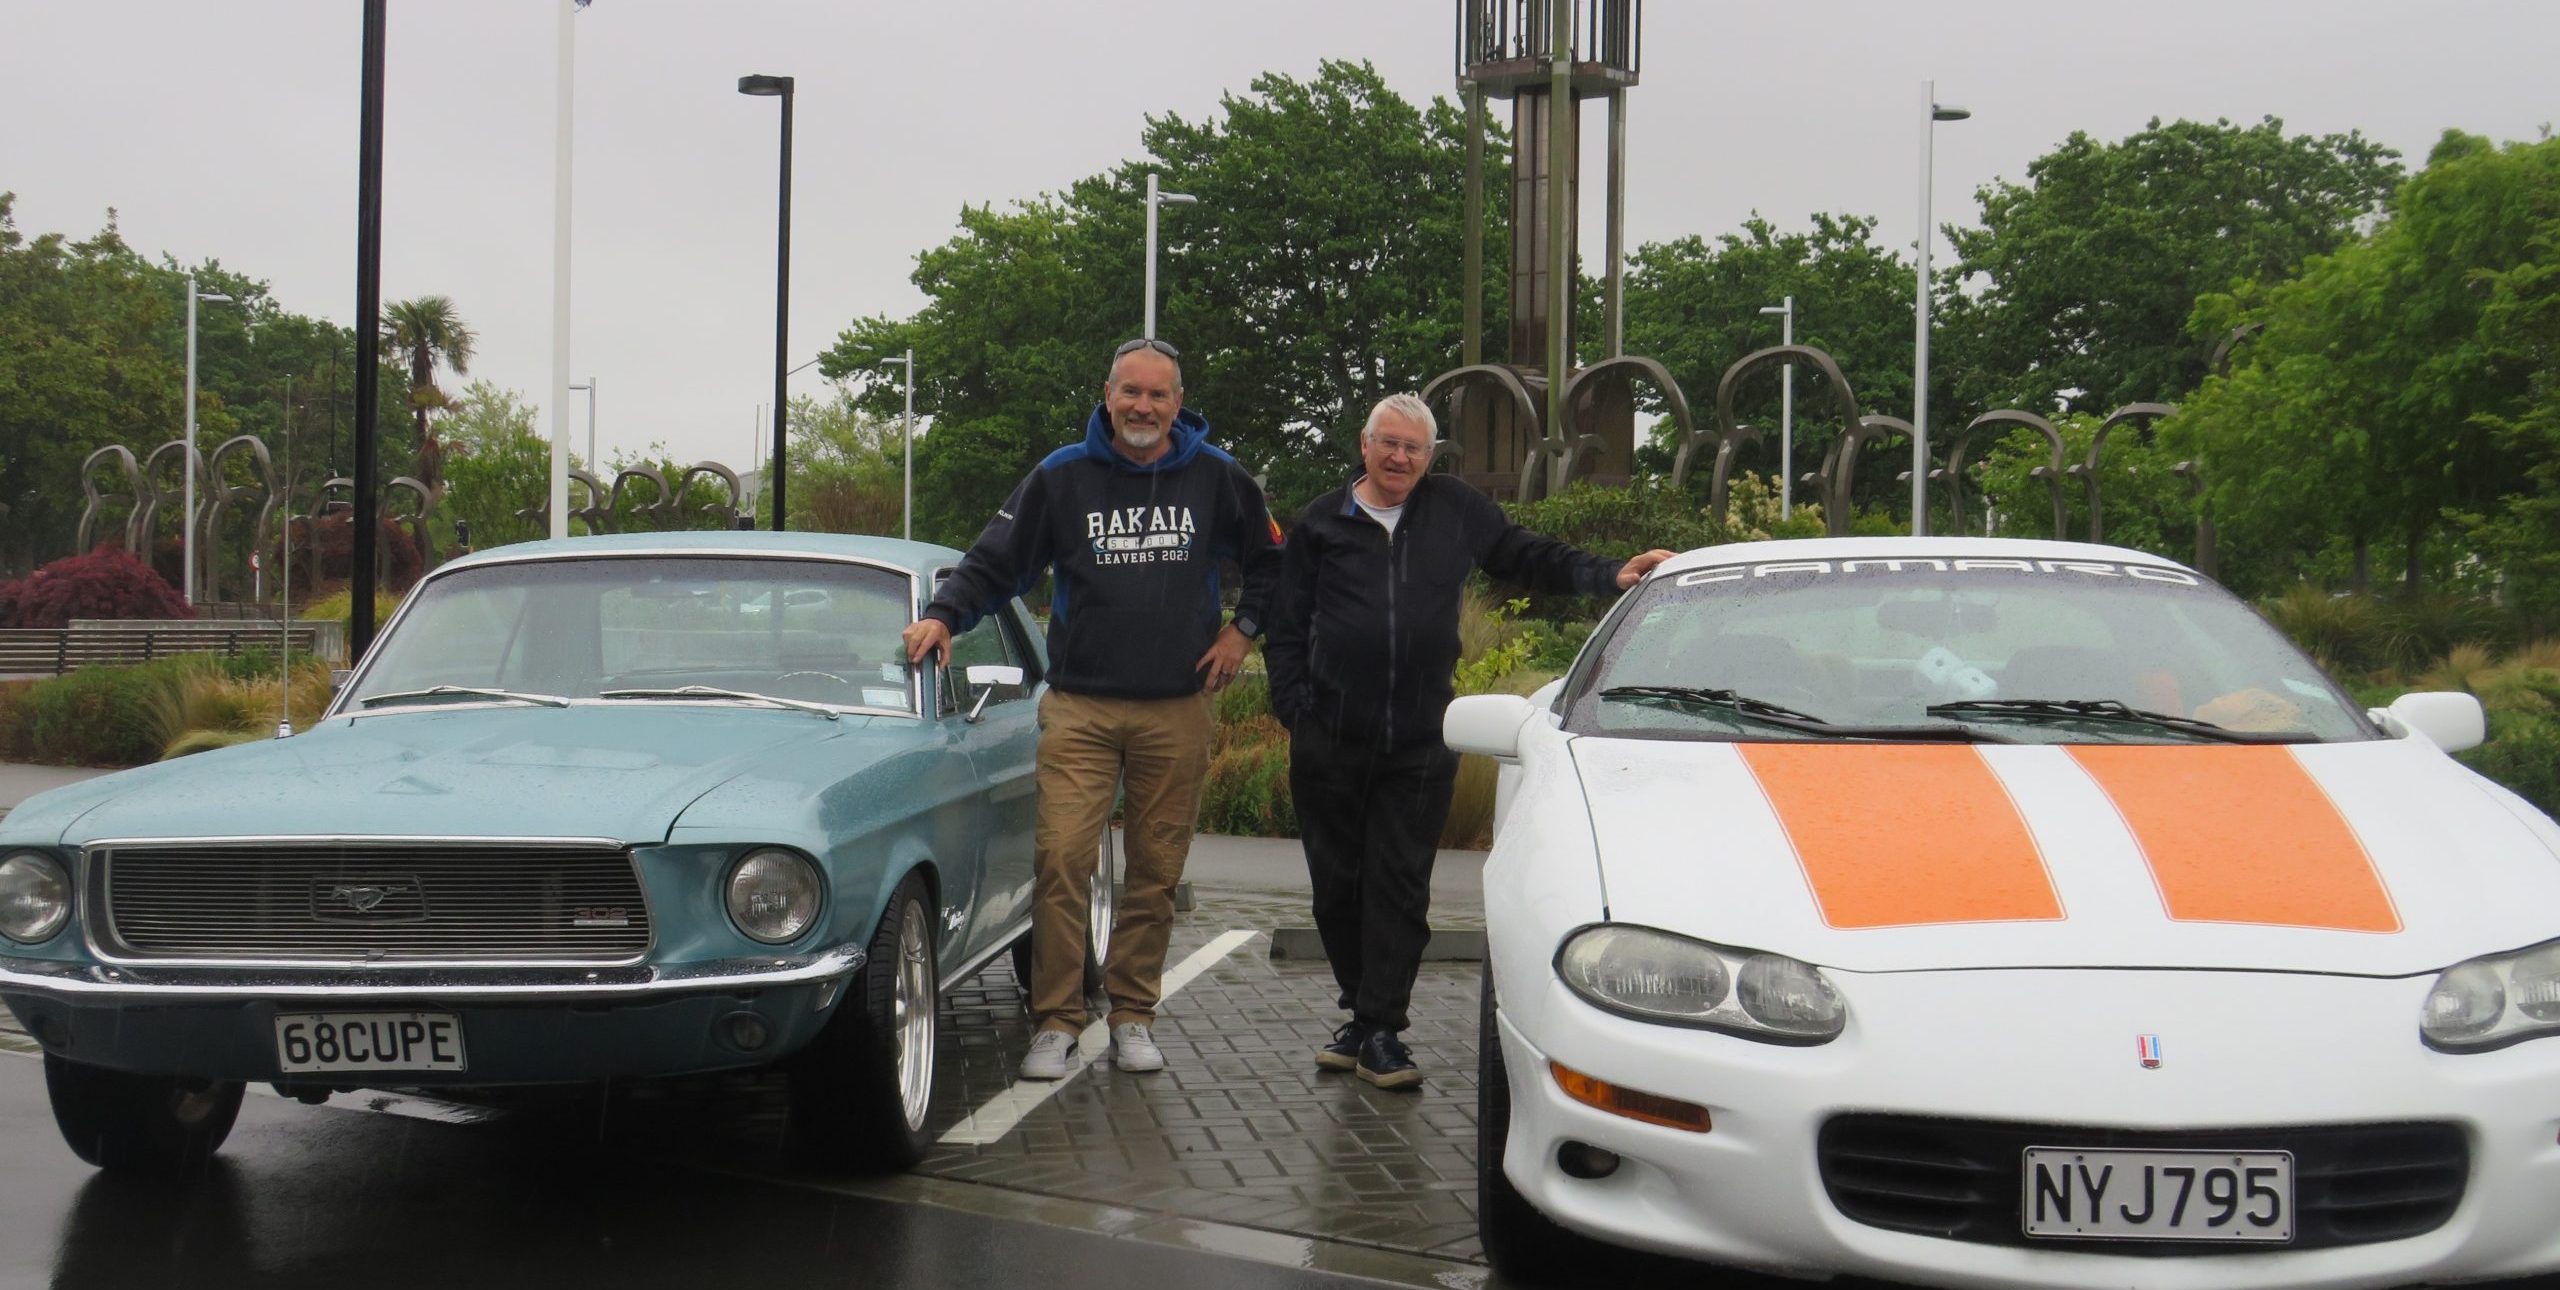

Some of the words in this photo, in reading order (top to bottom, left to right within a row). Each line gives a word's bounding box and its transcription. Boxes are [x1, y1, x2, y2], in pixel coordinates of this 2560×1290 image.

[1087, 506, 1196, 538] RAKAIA
[1111, 535, 1177, 549] SCHOOL
[1096, 551, 1155, 565] LEAVERS
[1162, 550, 1189, 561] 2023
[1676, 558, 2199, 587] CAMARO
[574, 907, 627, 920] 302
[284, 1021, 456, 1064] 68CUPE
[2036, 1163, 2280, 1227] NYJ795
